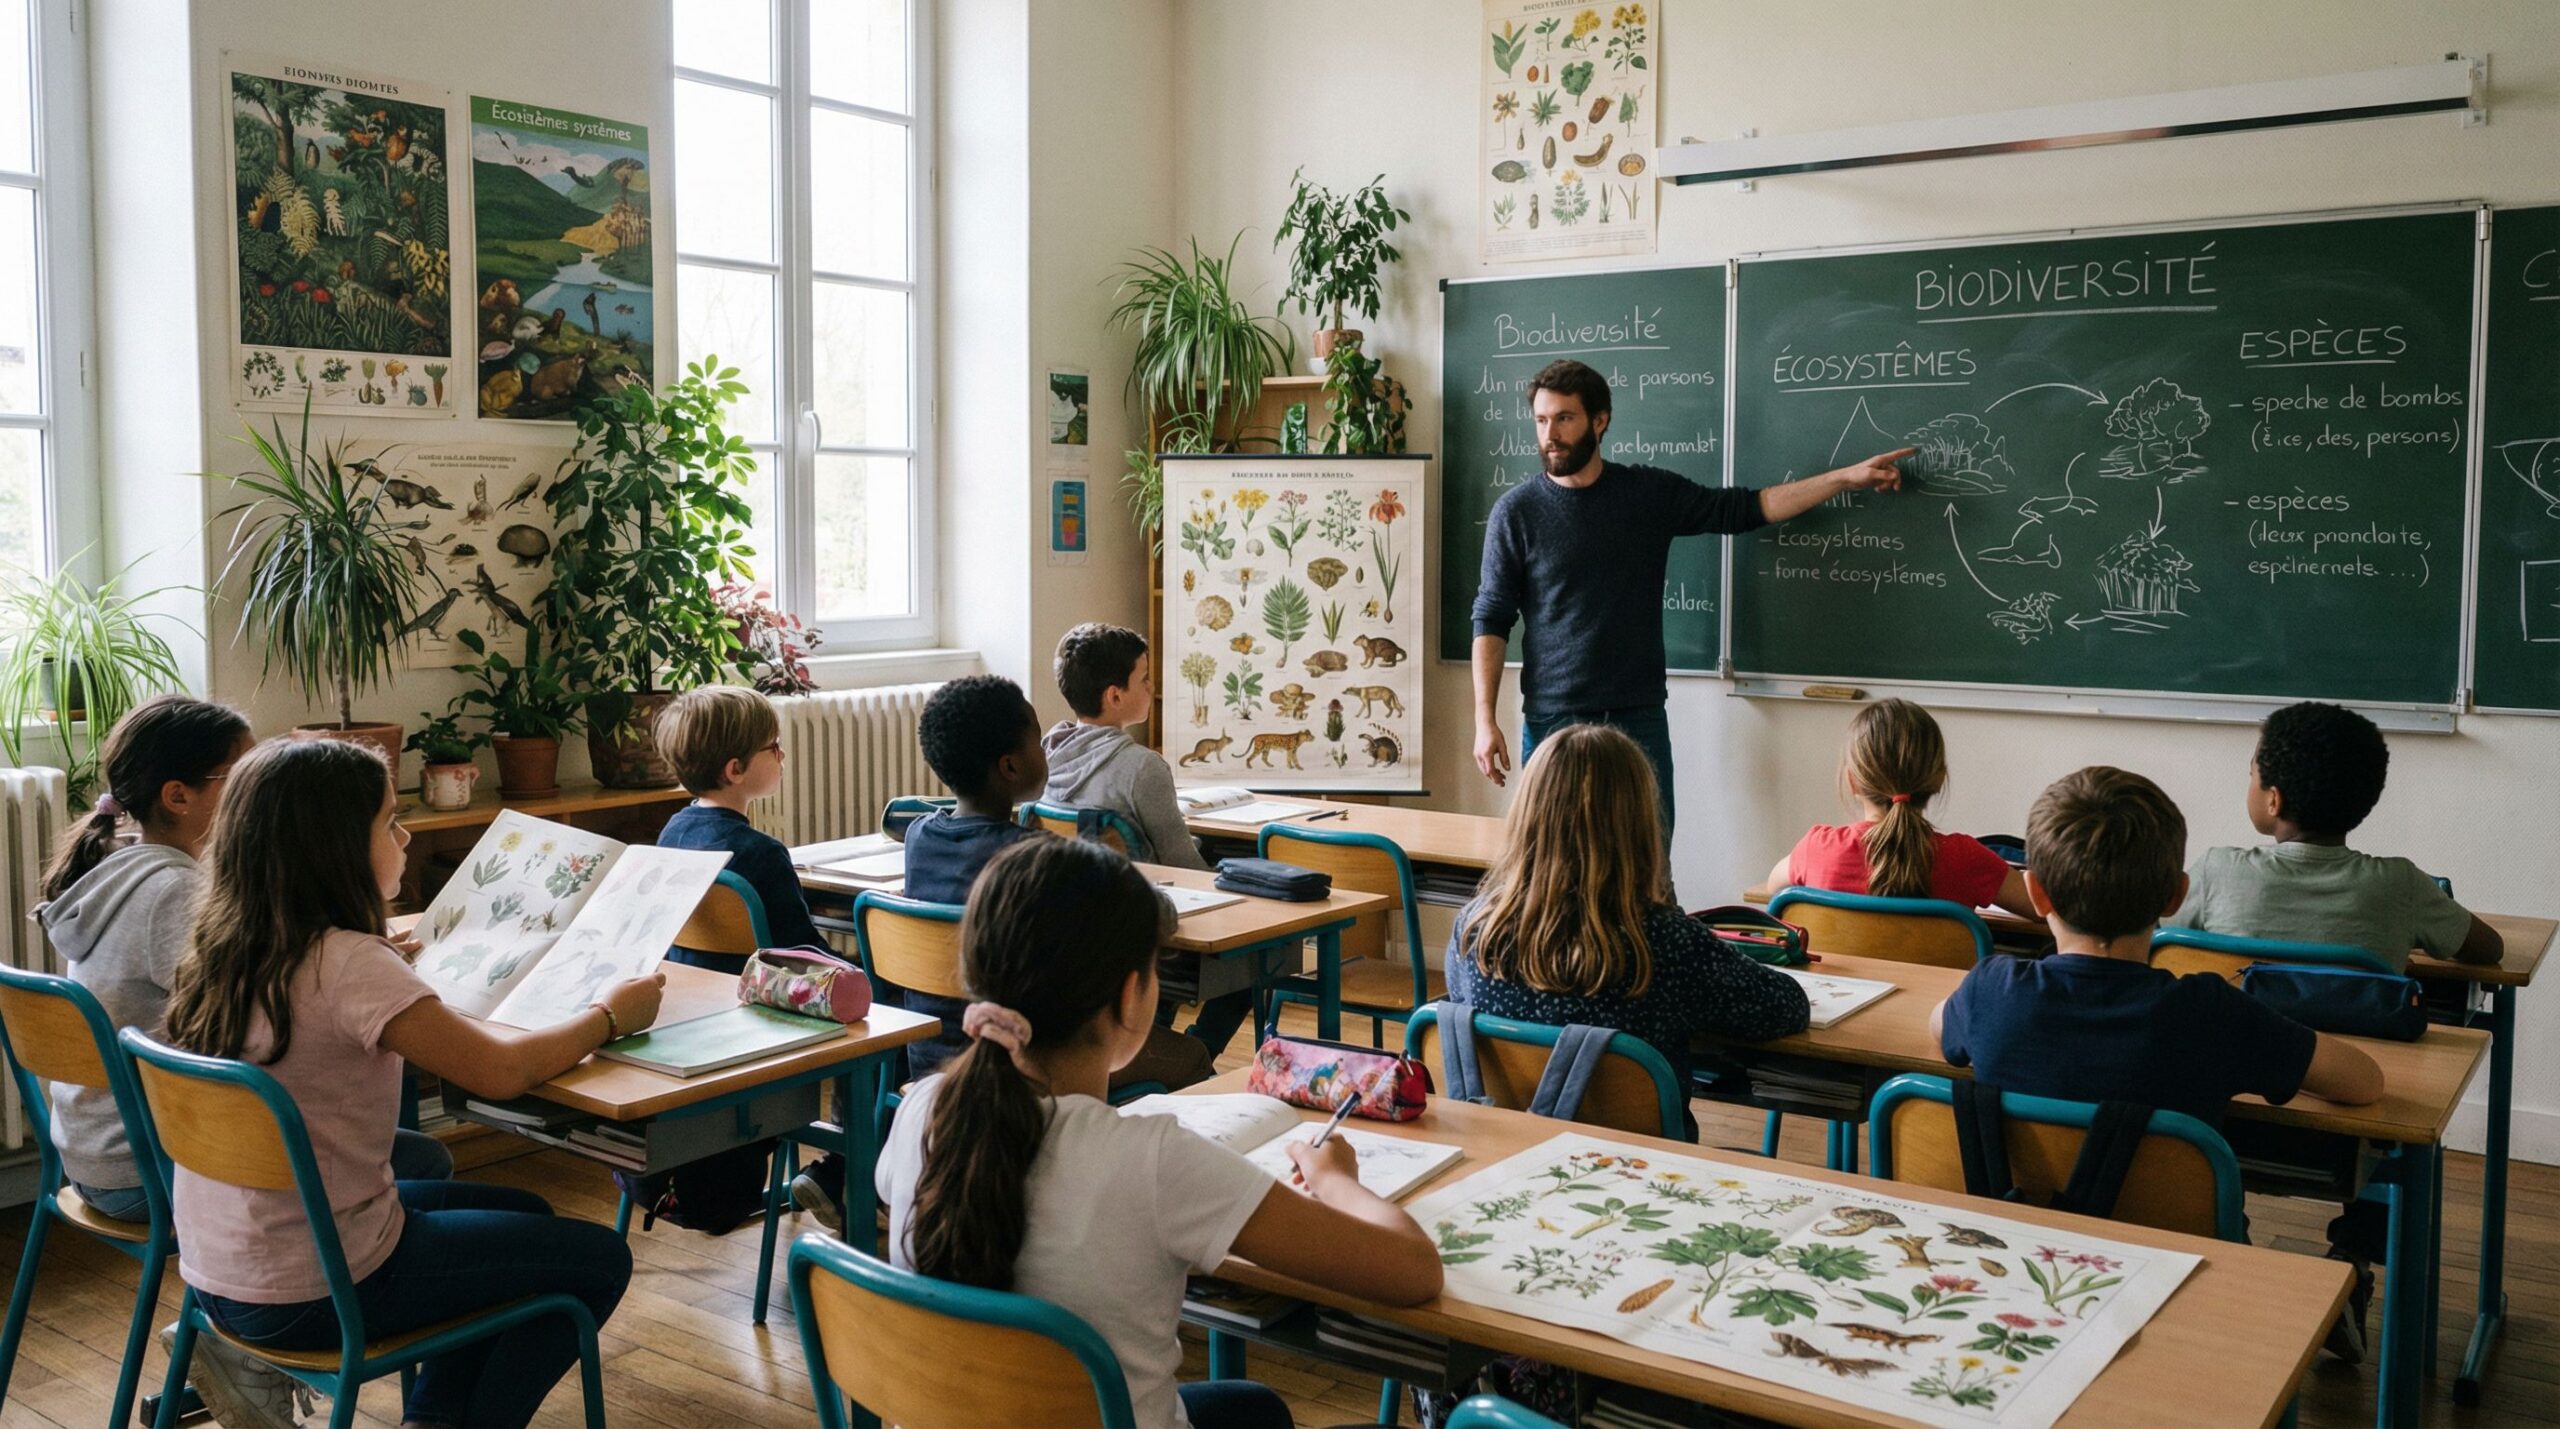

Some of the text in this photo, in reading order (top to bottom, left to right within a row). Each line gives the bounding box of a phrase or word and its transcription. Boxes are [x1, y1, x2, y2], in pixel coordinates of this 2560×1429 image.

[1494, 305, 1662, 349] Biodiversité
[2240, 318, 2406, 359] ESPÈCES
[1607, 366, 1629, 387] de
[1774, 340, 1977, 383] ÉCOSYSTÊMES
[1483, 400, 1503, 421] de
[2252, 384, 2329, 424] speche
[2339, 384, 2367, 409] de
[2381, 381, 2463, 408] bombs
[2248, 486, 2350, 523] espèces
